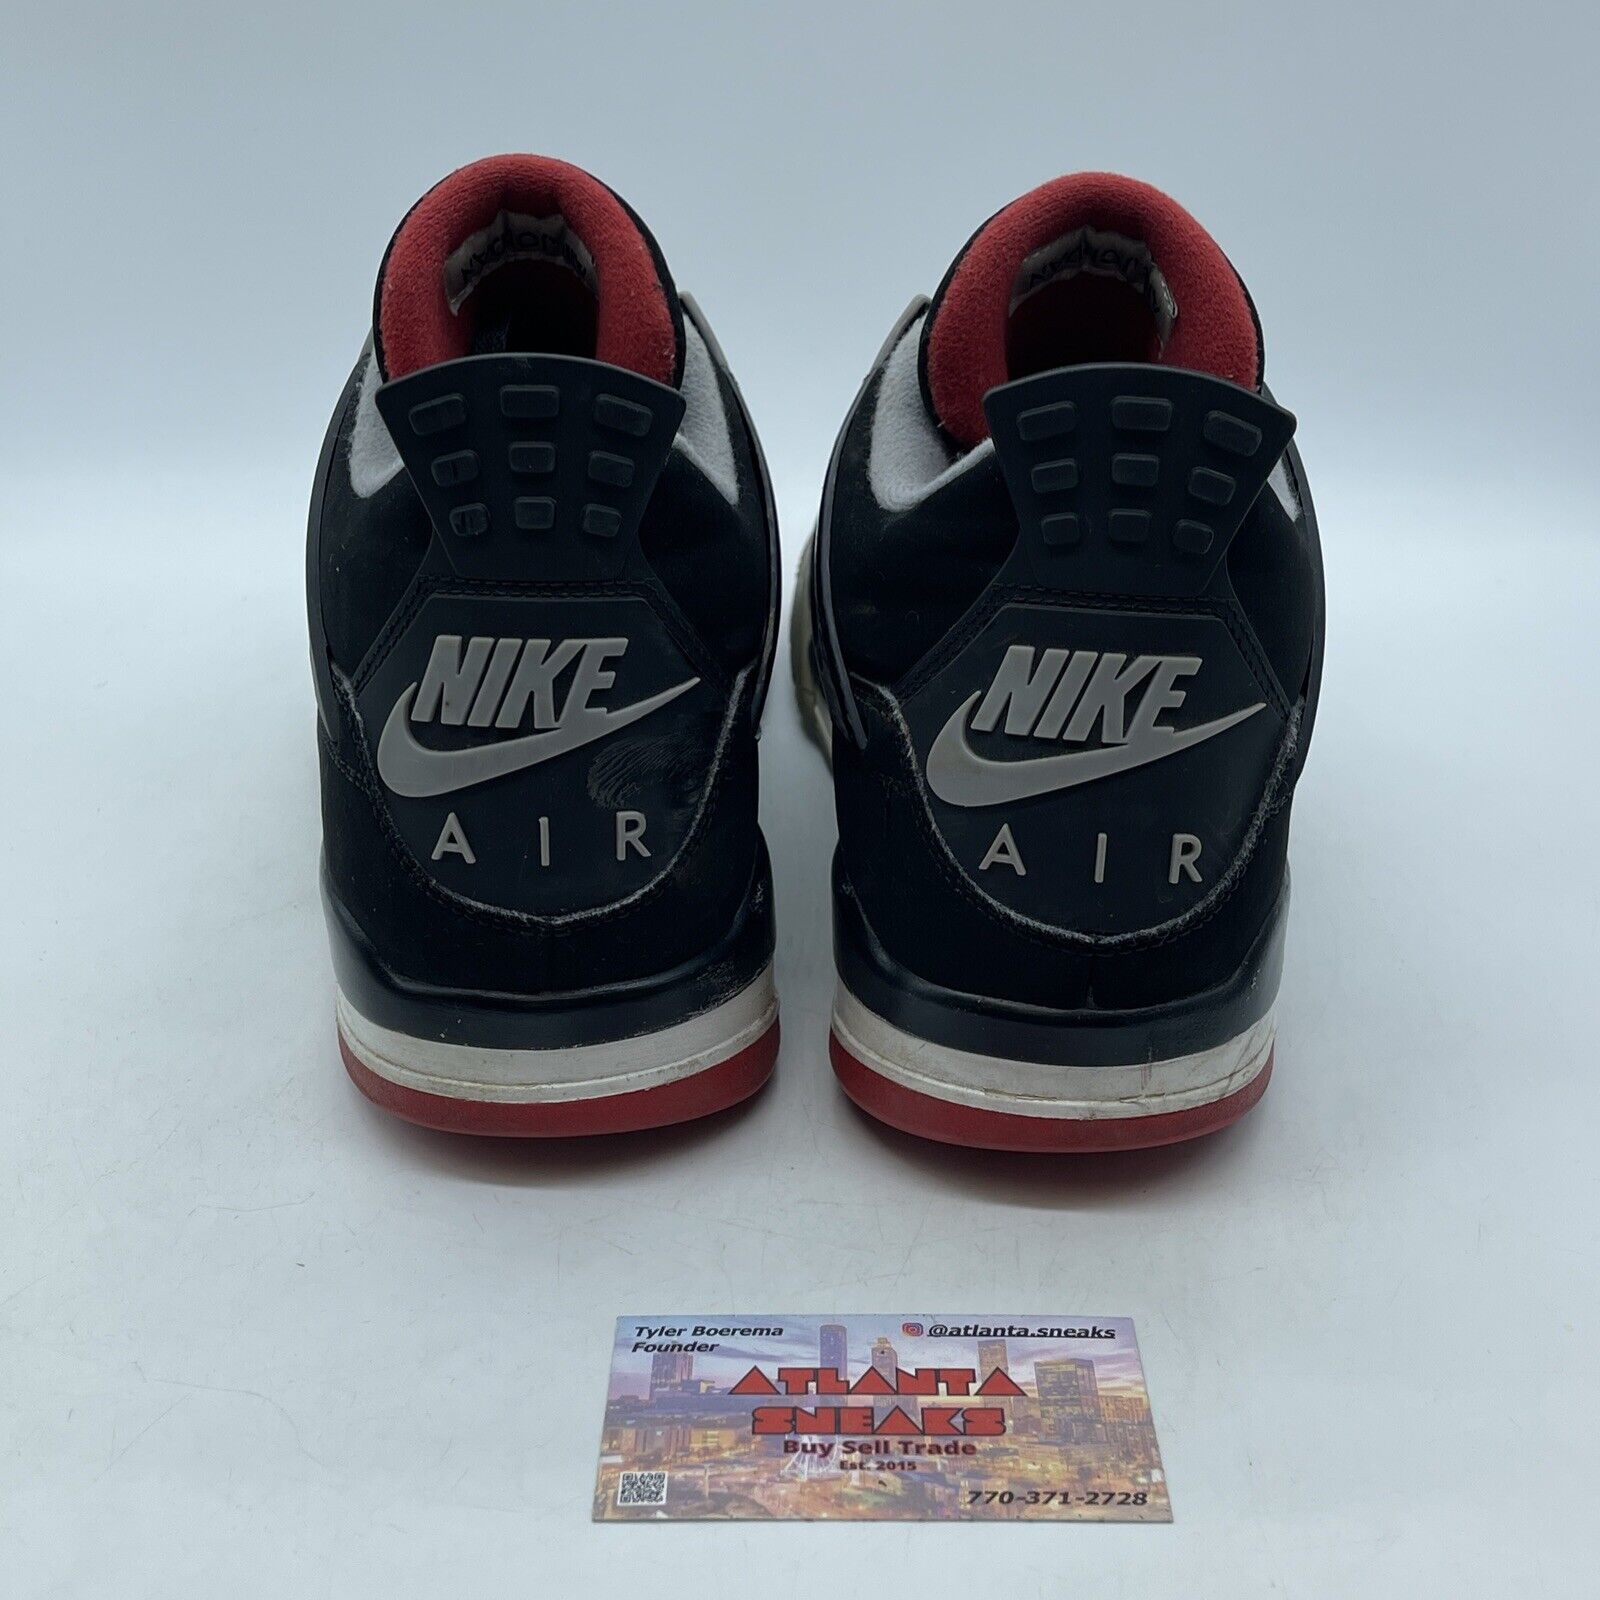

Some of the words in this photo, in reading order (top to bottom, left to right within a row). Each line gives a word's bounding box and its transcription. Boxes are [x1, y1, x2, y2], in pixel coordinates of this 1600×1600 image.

[410, 634, 629, 730] NIKE
[970, 645, 1203, 746] NIKE
[635, 1325, 687, 1340] Tyler
[691, 1325, 784, 1337] Boerema
[926, 1323, 1116, 1339] @atlanta.sneaks
[632, 1341, 720, 1353] Founder
[727, 1364, 1028, 1396] ATLANTA
[751, 1404, 1007, 1436] SNEAKS
[783, 1439, 834, 1458] Buy
[842, 1439, 890, 1455] Sell
[897, 1440, 977, 1456] Trade
[839, 1459, 871, 1471] Est.
[876, 1460, 917, 1471] 2015
[968, 1490, 1148, 1506] 770-371-2728
